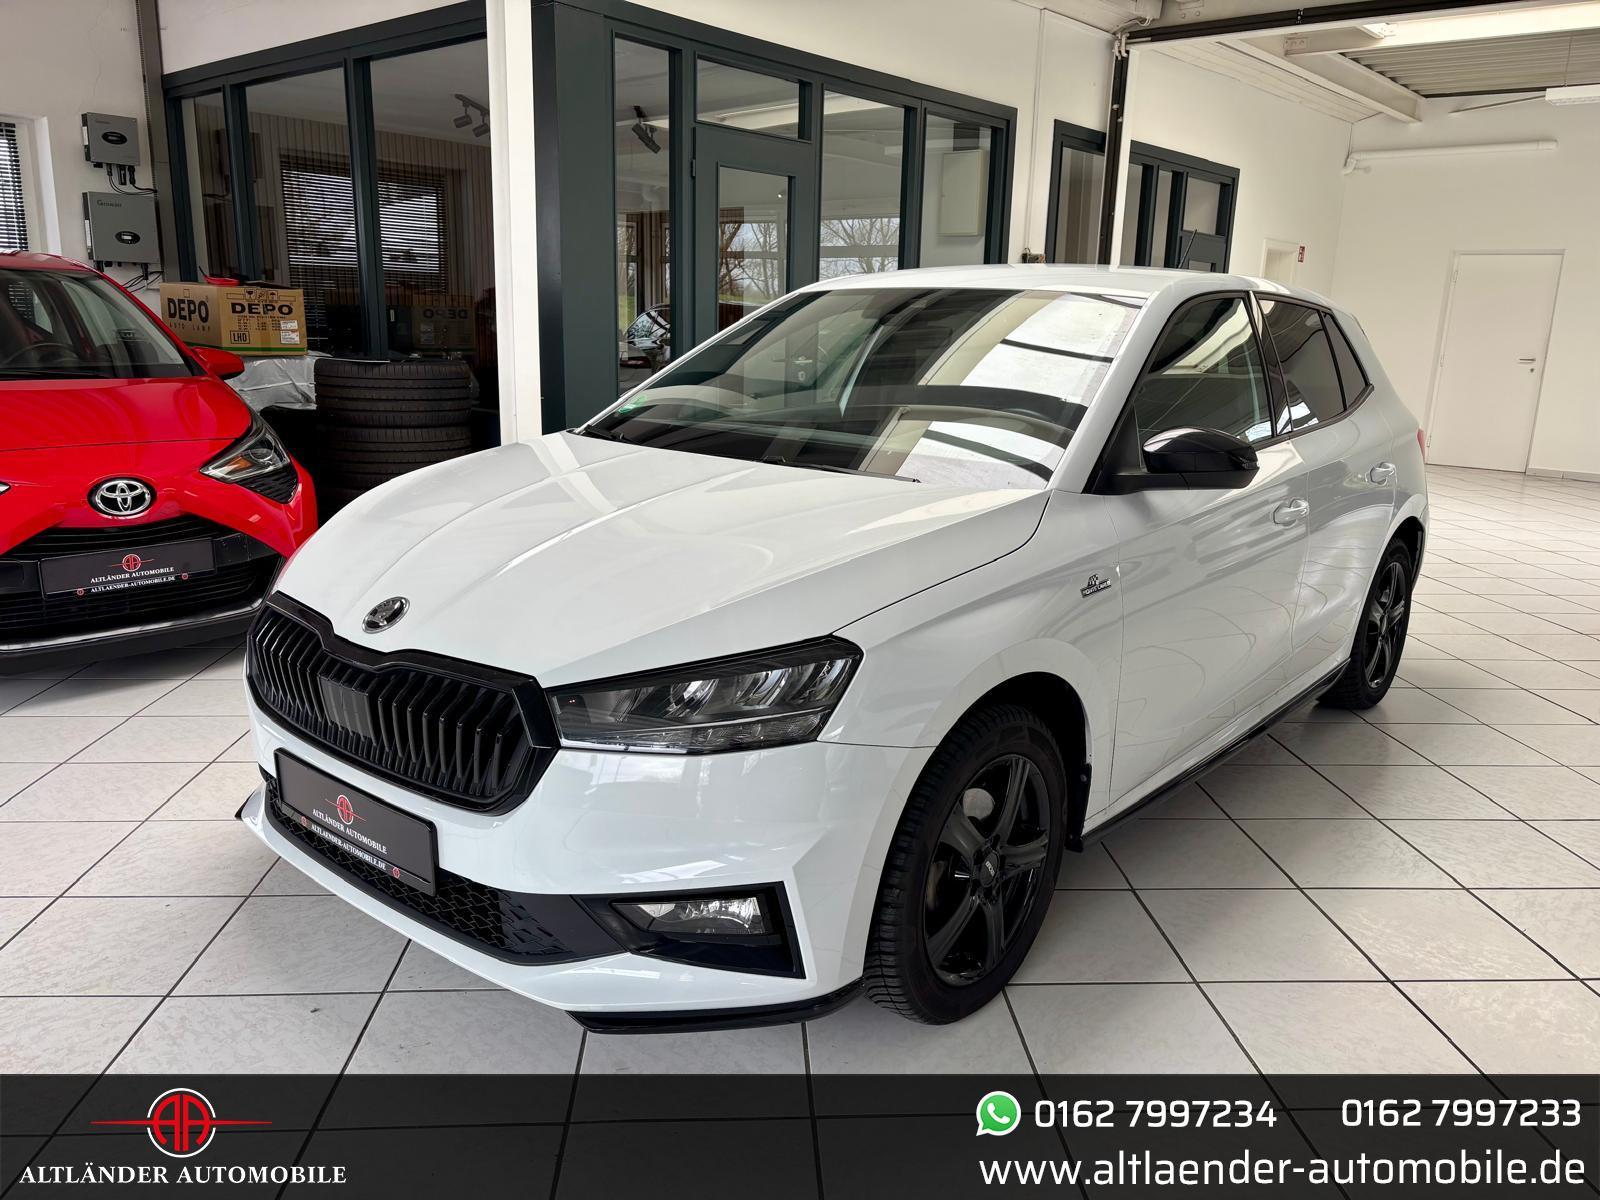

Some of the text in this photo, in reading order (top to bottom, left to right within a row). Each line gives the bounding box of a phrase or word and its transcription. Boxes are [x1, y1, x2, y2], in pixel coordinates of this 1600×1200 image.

[167, 298, 209, 323] DEPO
[231, 303, 293, 315] DEPO
[233, 333, 247, 342] LHD
[90, 567, 175, 583] ALTLÄNDER AUTOMOBILE
[312, 808, 388, 854] ALTLÄNDER AUTOMOBILE
